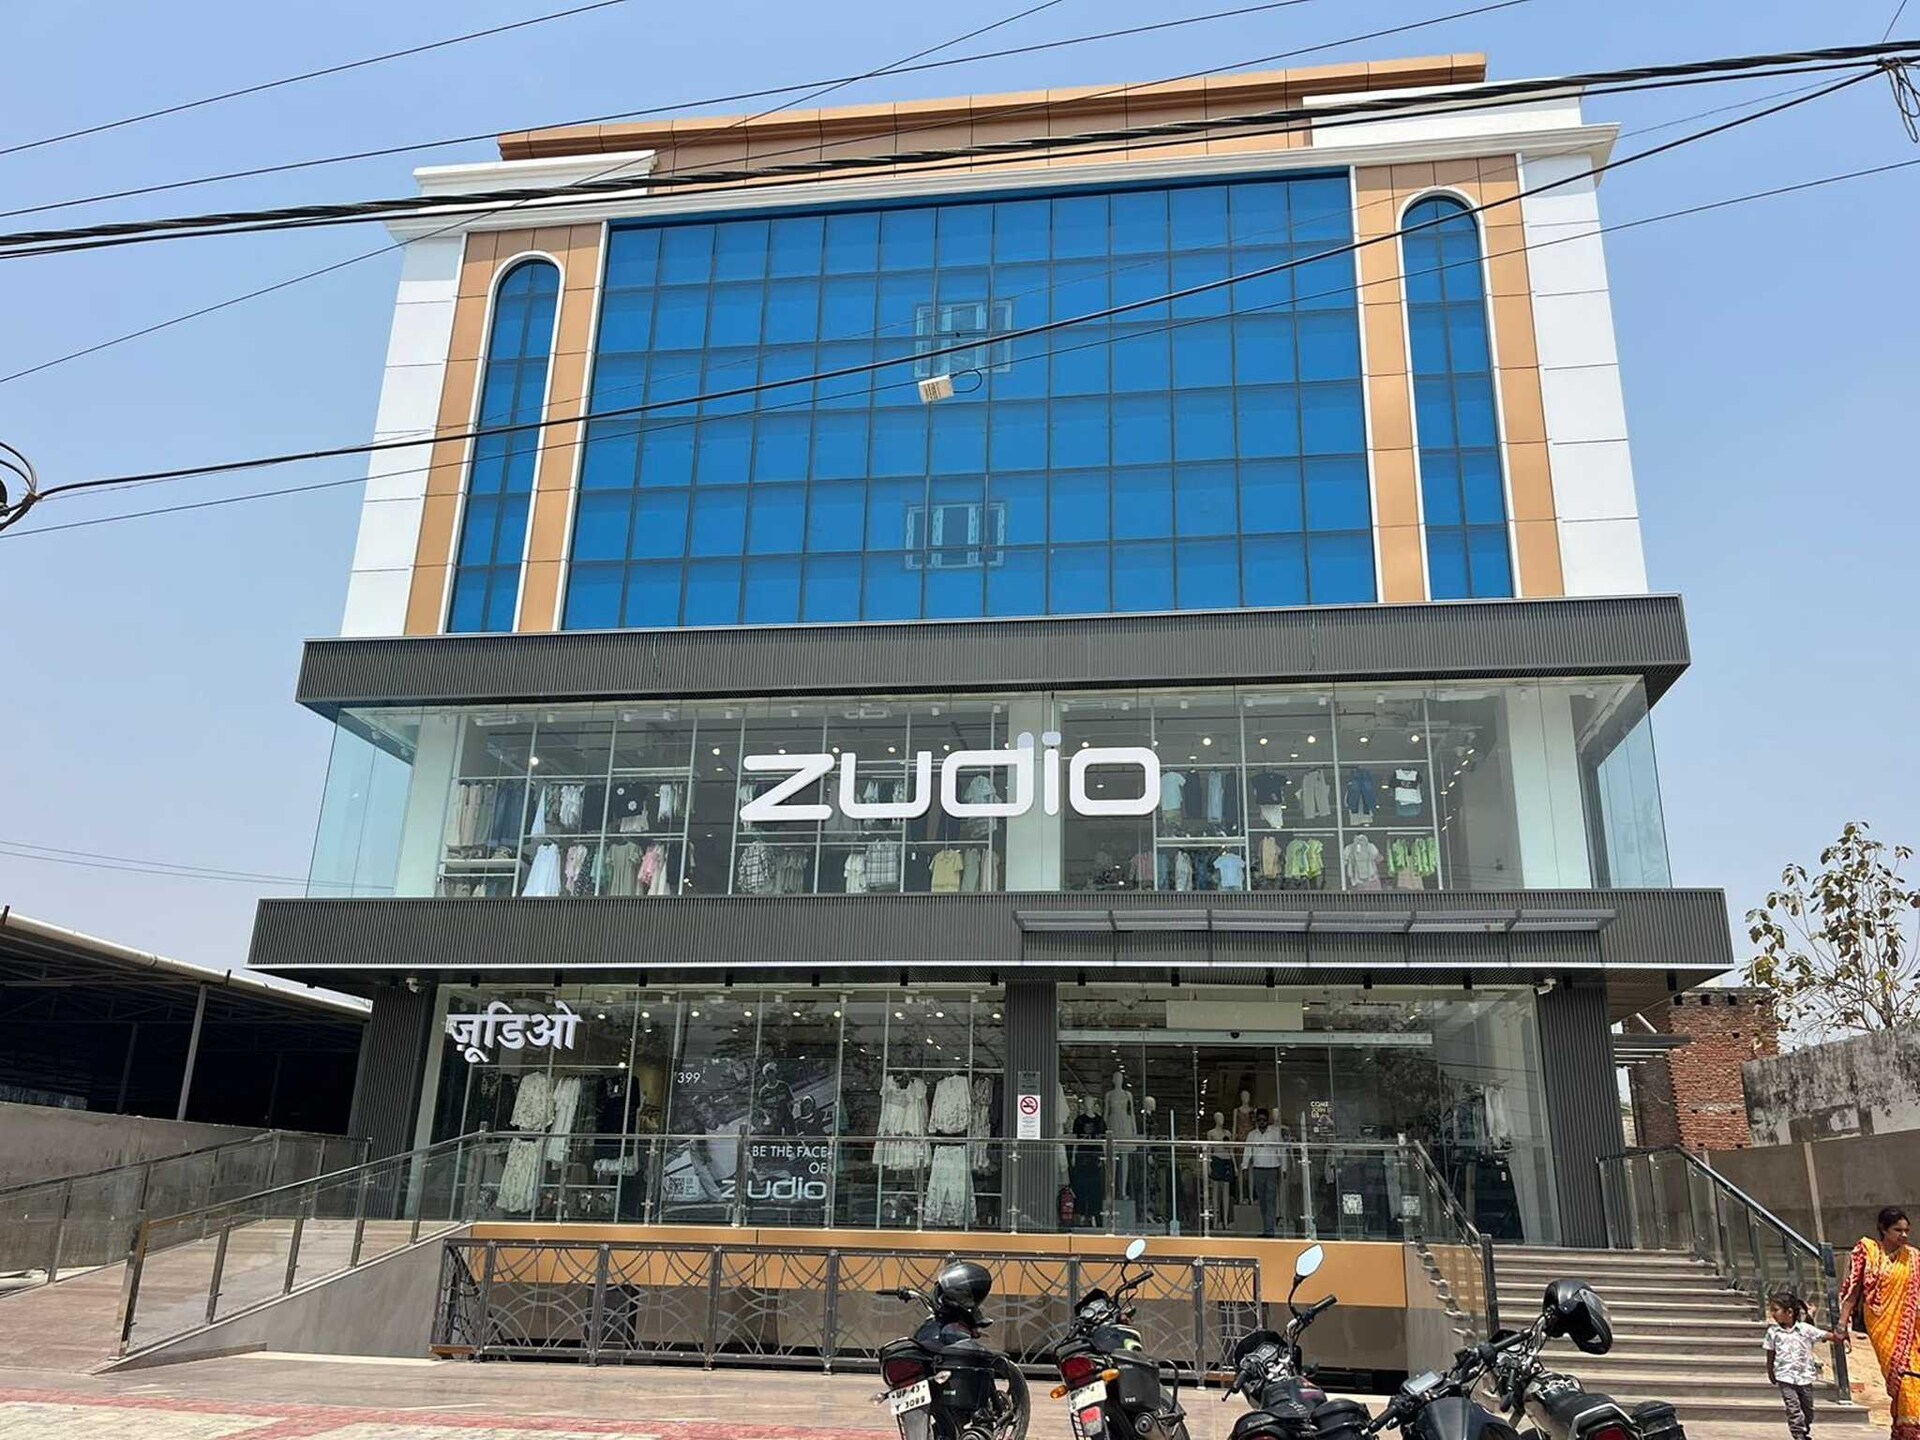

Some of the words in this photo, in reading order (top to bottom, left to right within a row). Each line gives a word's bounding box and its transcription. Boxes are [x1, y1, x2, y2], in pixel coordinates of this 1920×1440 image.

[740, 731, 1161, 821] zudio
[446, 1001, 583, 1063] ज़ूडिओ
[752, 1146, 766, 1157] BE
[771, 1146, 793, 1157] THE
[797, 1146, 828, 1158] FACE
[809, 1163, 827, 1174] OF
[721, 1177, 827, 1200] zudio
